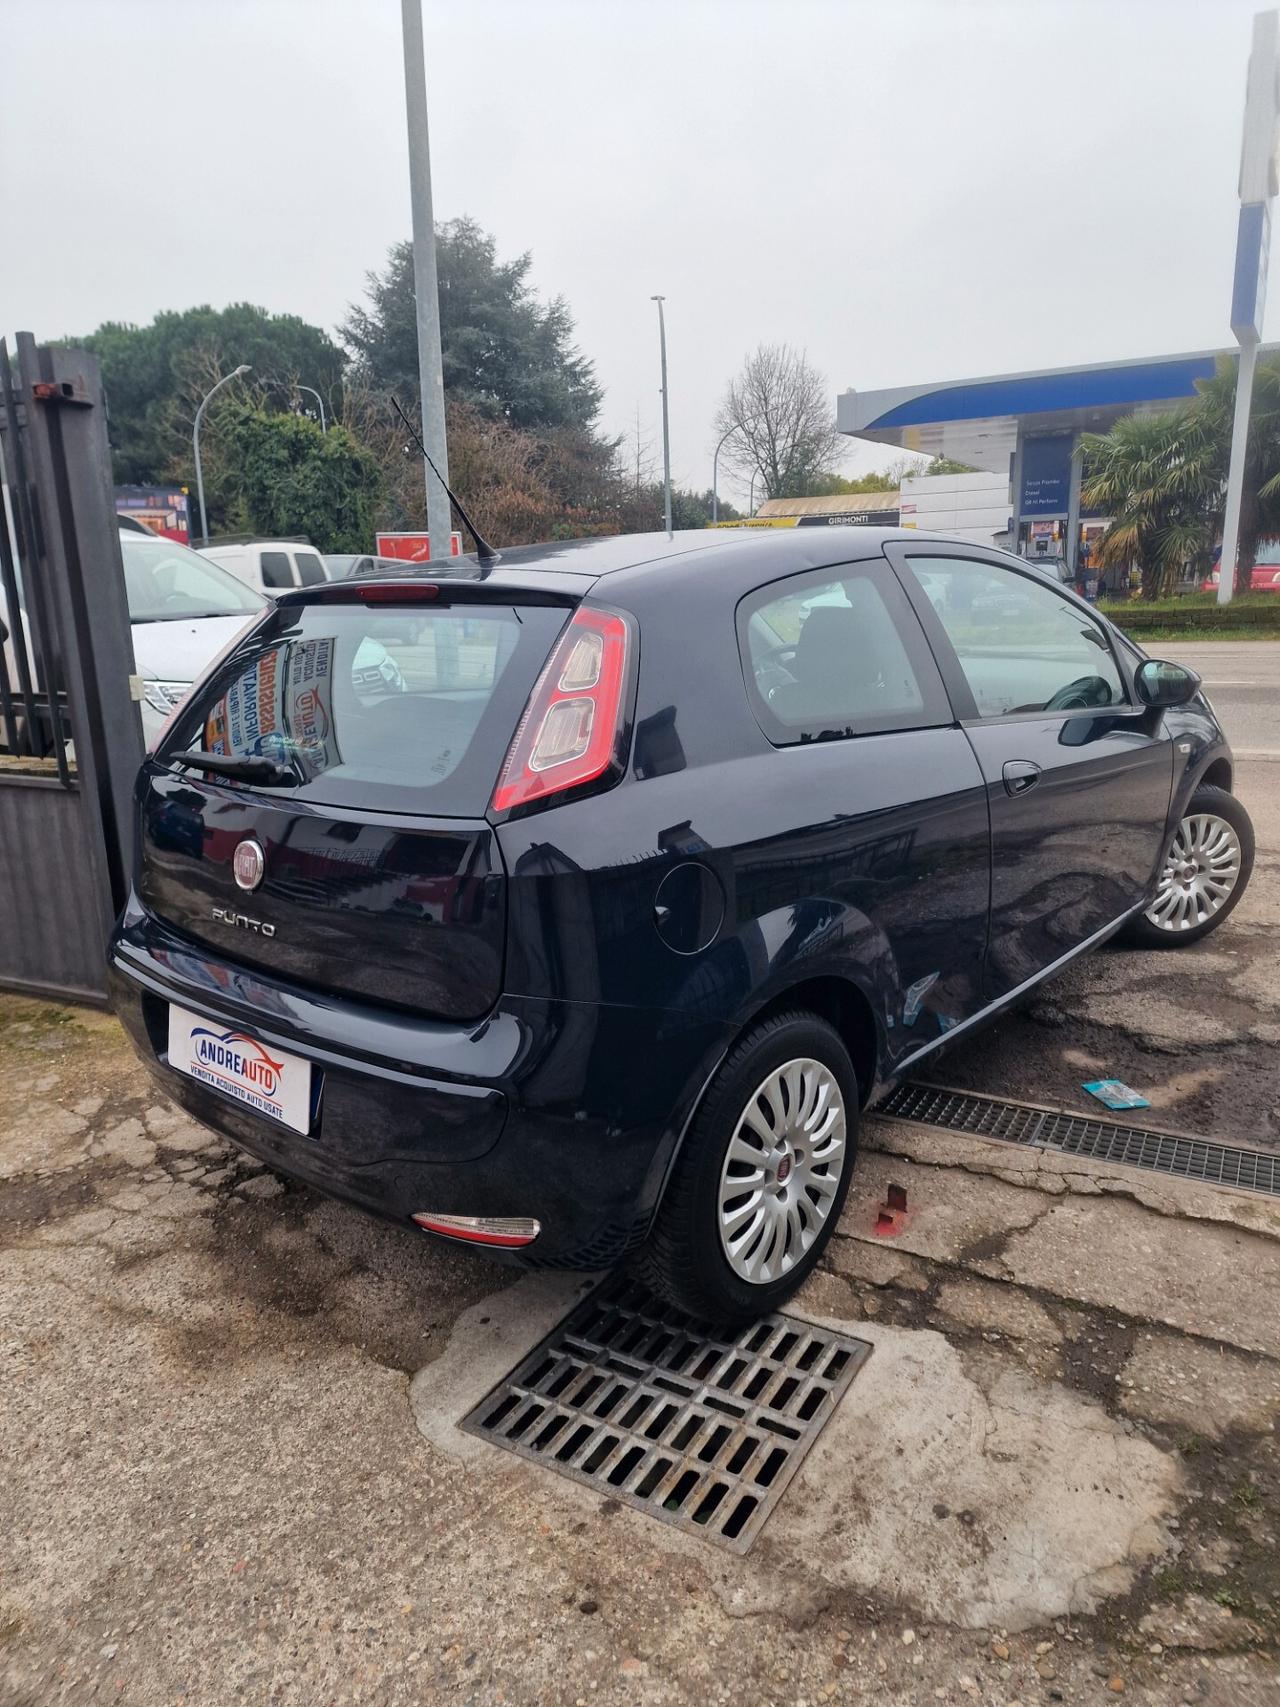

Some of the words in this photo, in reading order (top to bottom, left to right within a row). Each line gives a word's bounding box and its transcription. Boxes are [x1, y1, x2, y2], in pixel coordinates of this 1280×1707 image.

[828, 515, 869, 525] GIRIMONTI
[212, 908, 276, 936] PUNTO
[200, 1039, 272, 1089] ANDREAUTO
[191, 1065, 215, 1083] VENDITA
[216, 1077, 246, 1099] ACQUISTO
[247, 1092, 263, 1108] AUTO
[263, 1101, 283, 1119] USATE
